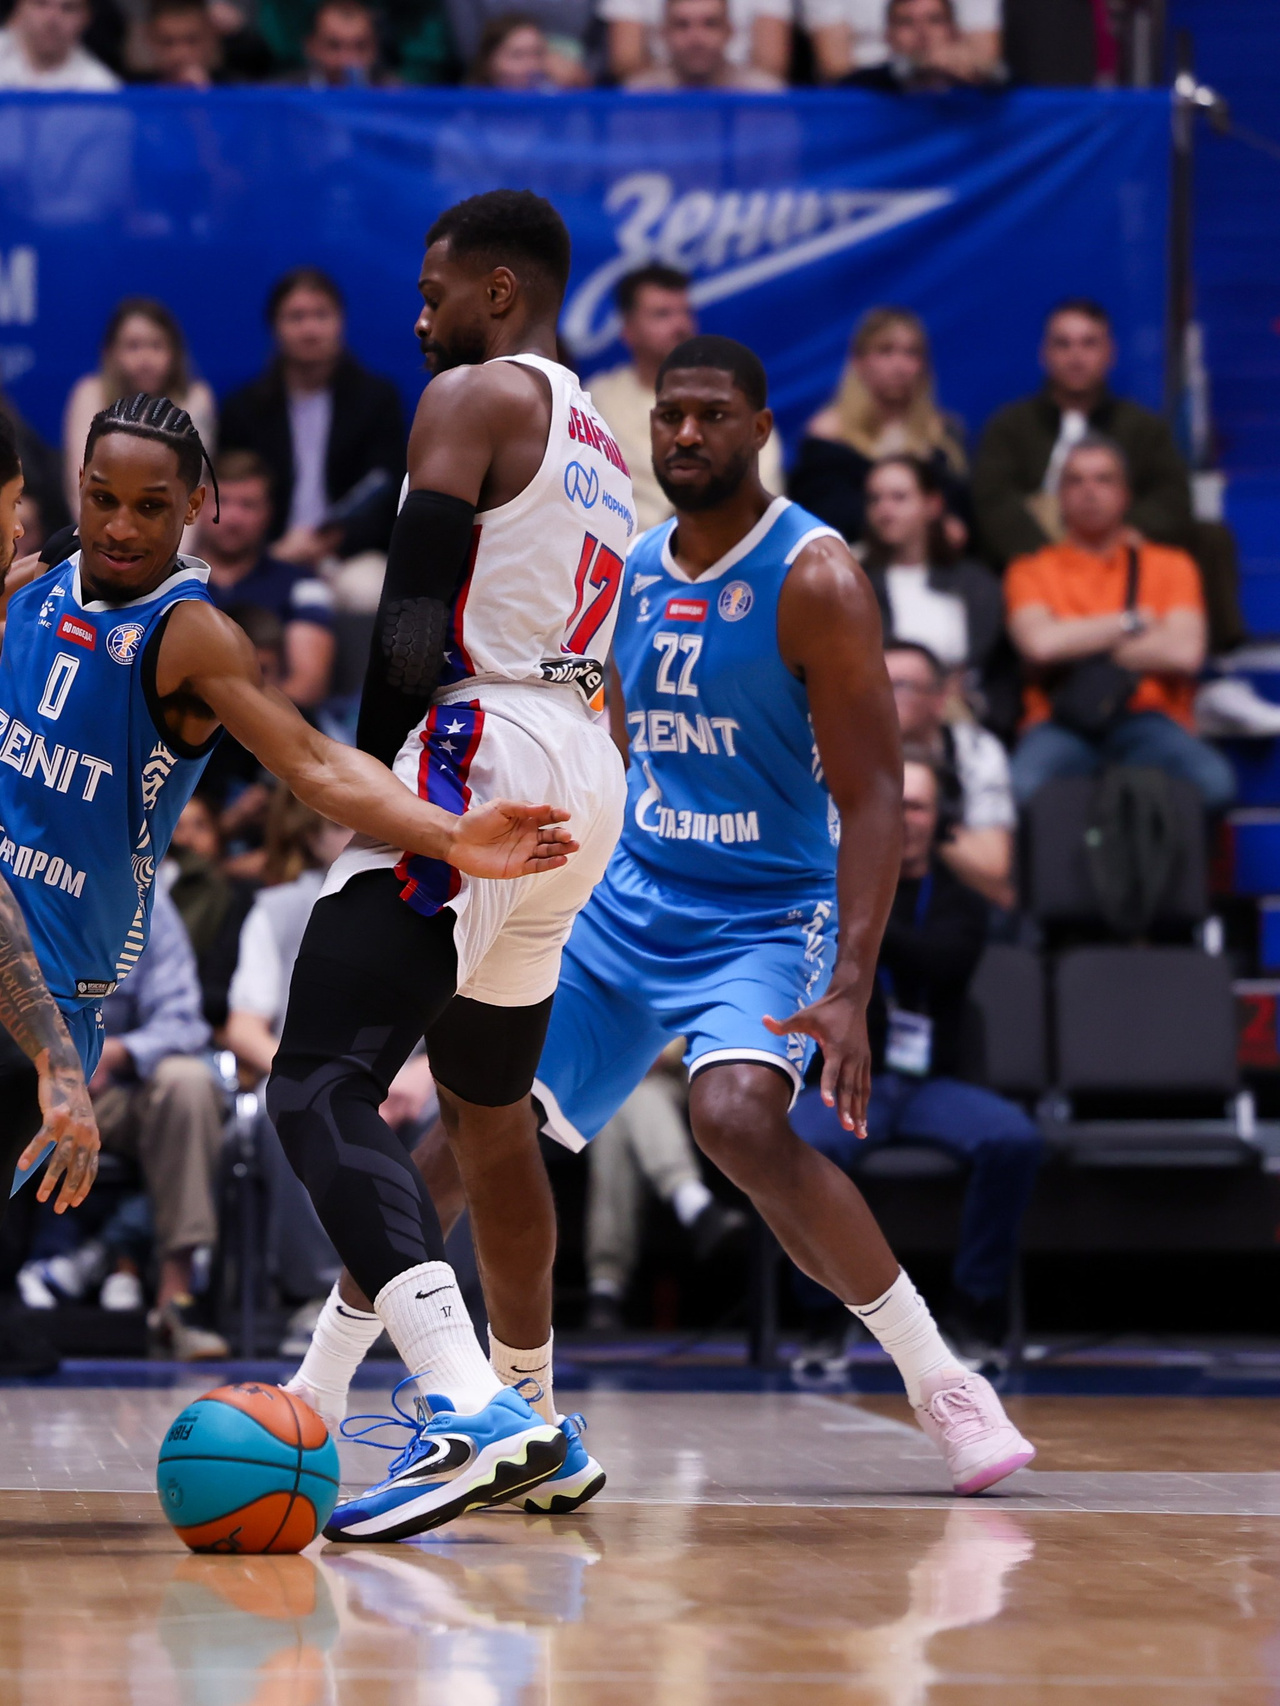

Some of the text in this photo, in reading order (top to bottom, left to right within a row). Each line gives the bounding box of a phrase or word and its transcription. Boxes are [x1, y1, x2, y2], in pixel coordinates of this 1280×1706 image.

[560, 531, 625, 655] 17
[37, 652, 80, 721] 0
[652, 631, 704, 697] 22
[658, 810, 760, 843] ГАЗПРОМ
[439, 1305, 452, 1319] 17
